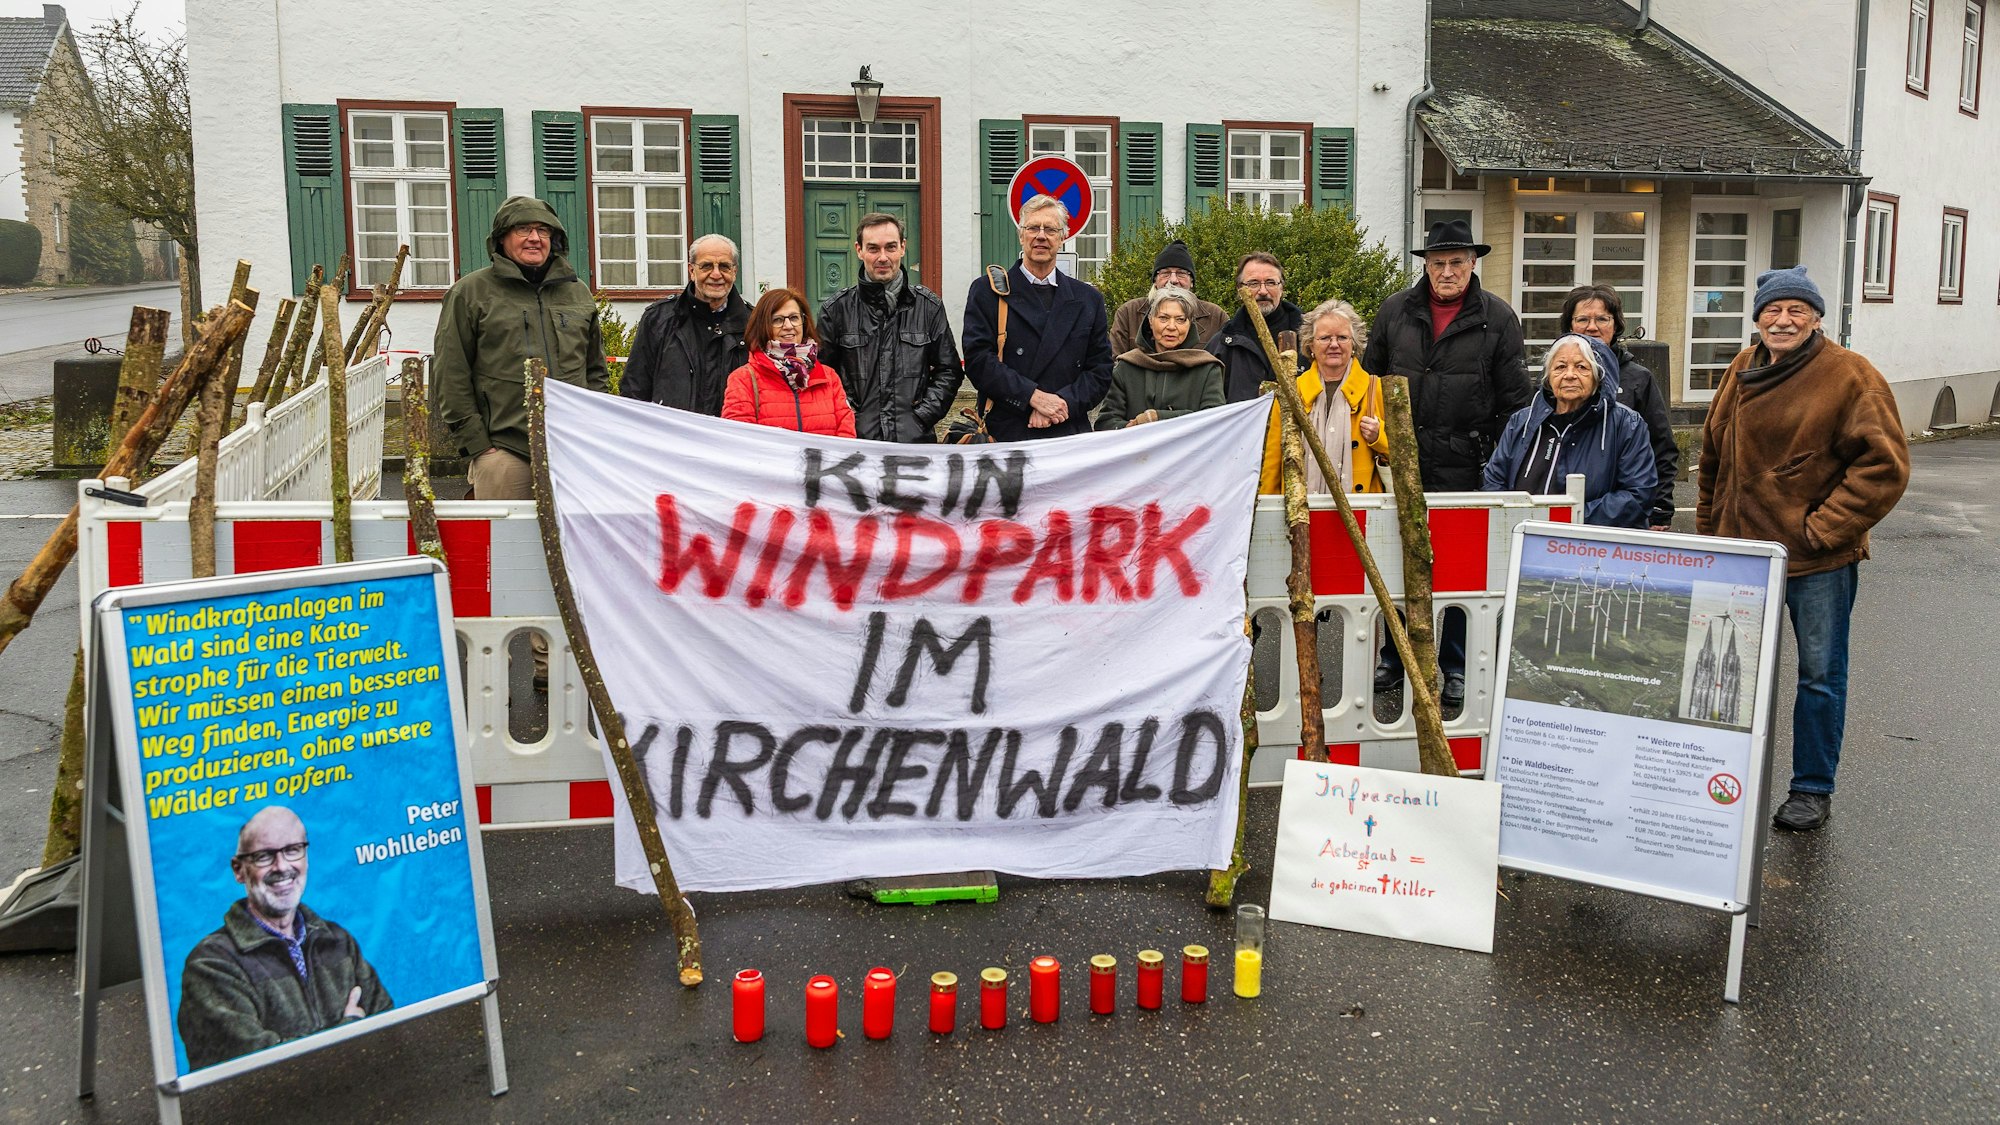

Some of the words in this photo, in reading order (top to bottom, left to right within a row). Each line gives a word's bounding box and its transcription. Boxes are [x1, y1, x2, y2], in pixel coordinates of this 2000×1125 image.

[803, 448, 1027, 518] KEIN
[656, 492, 1211, 611] WINDPARK
[1546, 540, 1608, 559] Schöne
[1612, 546, 1716, 568] Aussichten?
[359, 587, 385, 608] im
[132, 643, 193, 667] Wald
[201, 632, 250, 659] sind
[255, 629, 303, 653] eine
[310, 620, 369, 644] Kata-
[135, 664, 230, 699] strophe
[236, 659, 270, 688] für
[275, 652, 309, 678] die
[315, 640, 408, 672] Tierwelt.
[849, 611, 991, 714] IM
[1546, 663, 1661, 686] www.windpark-wackerberg.de
[138, 703, 181, 728] Wir
[188, 693, 274, 723] müssen
[281, 679, 343, 704] einen
[350, 663, 440, 696] besseren
[142, 733, 194, 760] Weg
[202, 720, 282, 754] finden,
[288, 703, 370, 735] Energie
[376, 698, 398, 718] zu
[1512, 716, 1525, 724] Der
[1526, 717, 1572, 732] (potentielle)
[1574, 726, 1607, 737] Investor:
[1569, 737, 1599, 746] Euskirchen
[1651, 737, 1680, 749] Weitere
[1682, 742, 1705, 752] Infos:
[145, 748, 296, 793] produzieren,
[302, 729, 356, 760] ohne
[362, 720, 432, 749] unsere
[1511, 758, 1523, 766] Die
[1524, 761, 1574, 774] Waldbesitzer:
[1635, 754, 1665, 763] Redaktion:
[1666, 759, 1690, 768] Manfred
[1691, 763, 1713, 771] Kanzler
[1636, 746, 1661, 754] Initiative
[1662, 749, 1689, 759] Windpark
[1691, 754, 1726, 765] Wackerberg
[1509, 767, 1539, 777] Katholische
[1540, 772, 1586, 785] Kirchengemeinde
[1634, 763, 1667, 774] Wackerberg
[149, 787, 237, 820] Wälder
[243, 780, 268, 800] zu
[274, 763, 354, 797] opfern.
[1502, 784, 1605, 806] ellenthalschleiden@bistum-aachen.de
[1632, 780, 1700, 796] kanzler@wackerberg.de
[407, 800, 461, 825] Peter
[1506, 794, 1543, 805] Arenbergische
[1544, 801, 1587, 814] Forstverwaltung
[1504, 812, 1530, 822] Gemeinde
[1557, 822, 1595, 834] Bürgermeister
[1546, 809, 1614, 827] office@arenberg-eifel.de
[1633, 807, 1650, 815] erhält
[1660, 811, 1674, 819] Jahre
[1675, 815, 1729, 829] EEG-Subventionen
[1635, 818, 1660, 827] erwarten
[355, 825, 462, 865] Wohlleben
[1541, 828, 1599, 843] posteingang@kall.de
[1708, 840, 1733, 849] Windrad
[1634, 846, 1674, 858] Steuerzahlern
[1635, 837, 1662, 847] finanziert
[1675, 844, 1714, 857] Stromkunden
[1310, 878, 1325, 888] die
[1392, 876, 1436, 898] Killer
